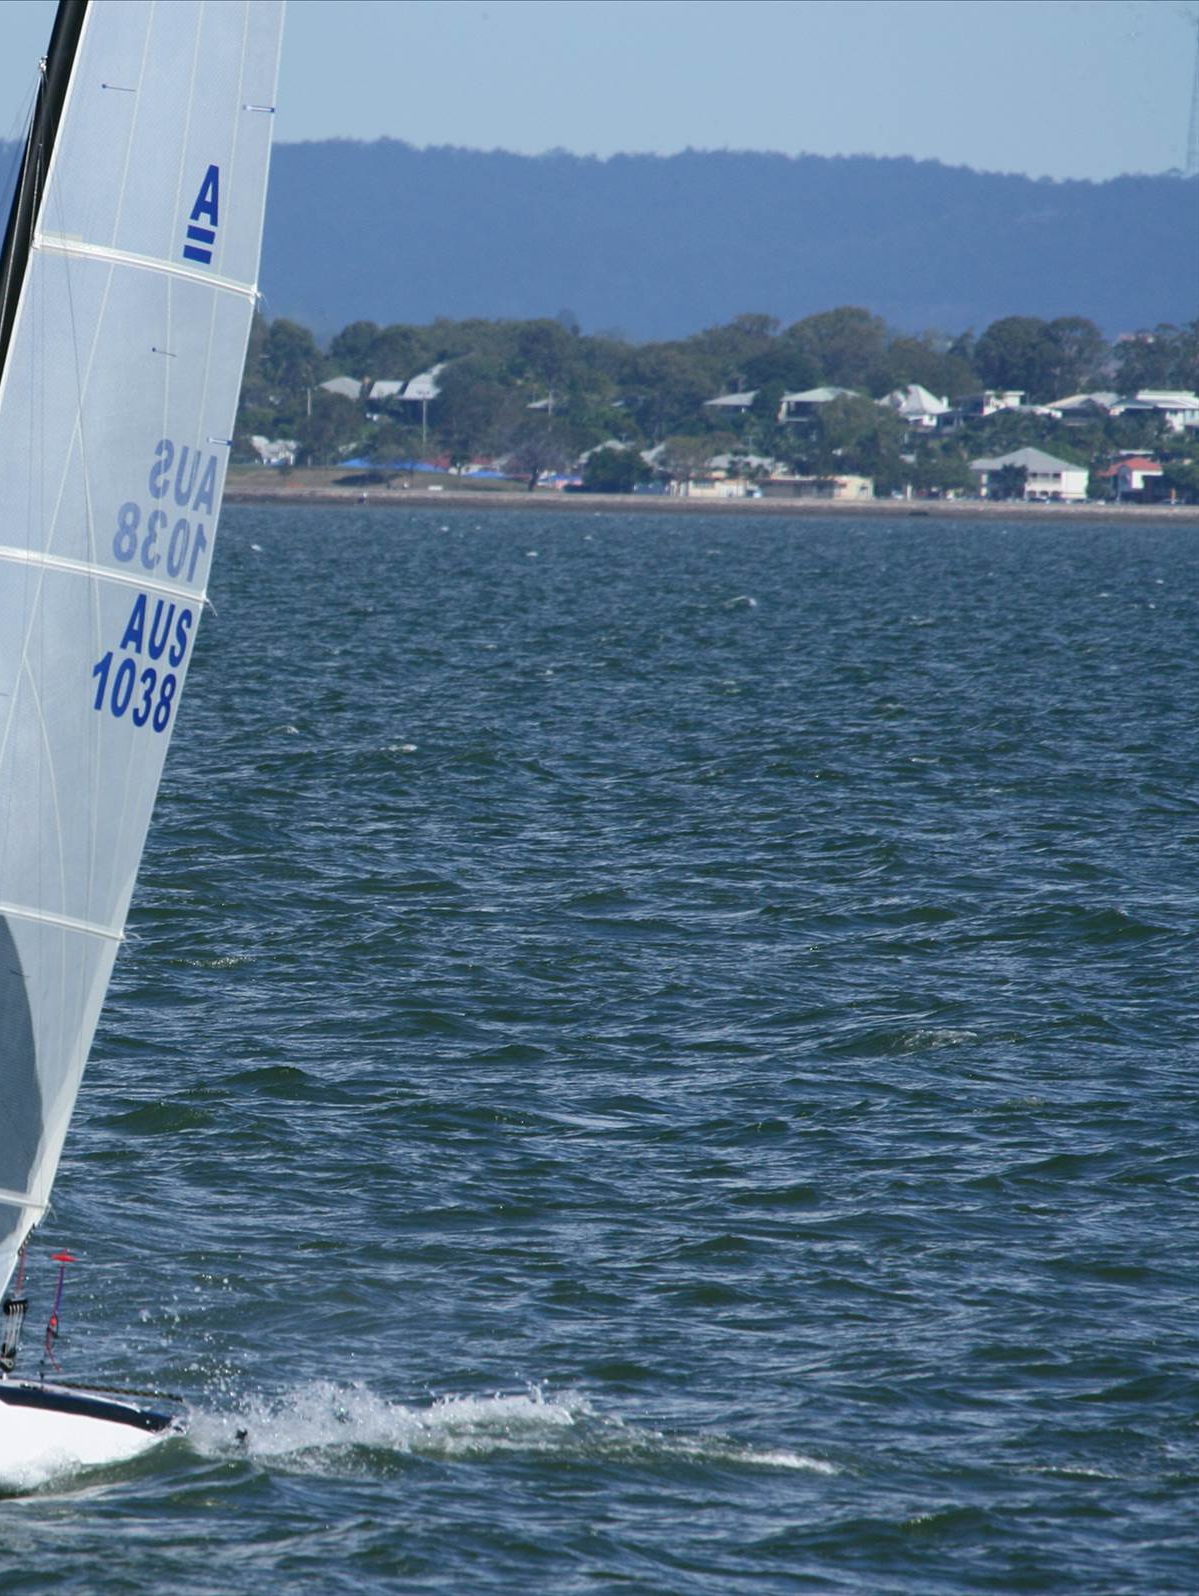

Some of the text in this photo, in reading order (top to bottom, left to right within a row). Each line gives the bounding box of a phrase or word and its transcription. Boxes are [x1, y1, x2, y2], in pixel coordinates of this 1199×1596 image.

[189, 164, 219, 227] A
[120, 593, 193, 668] AUS
[92, 651, 177, 733] 1038
